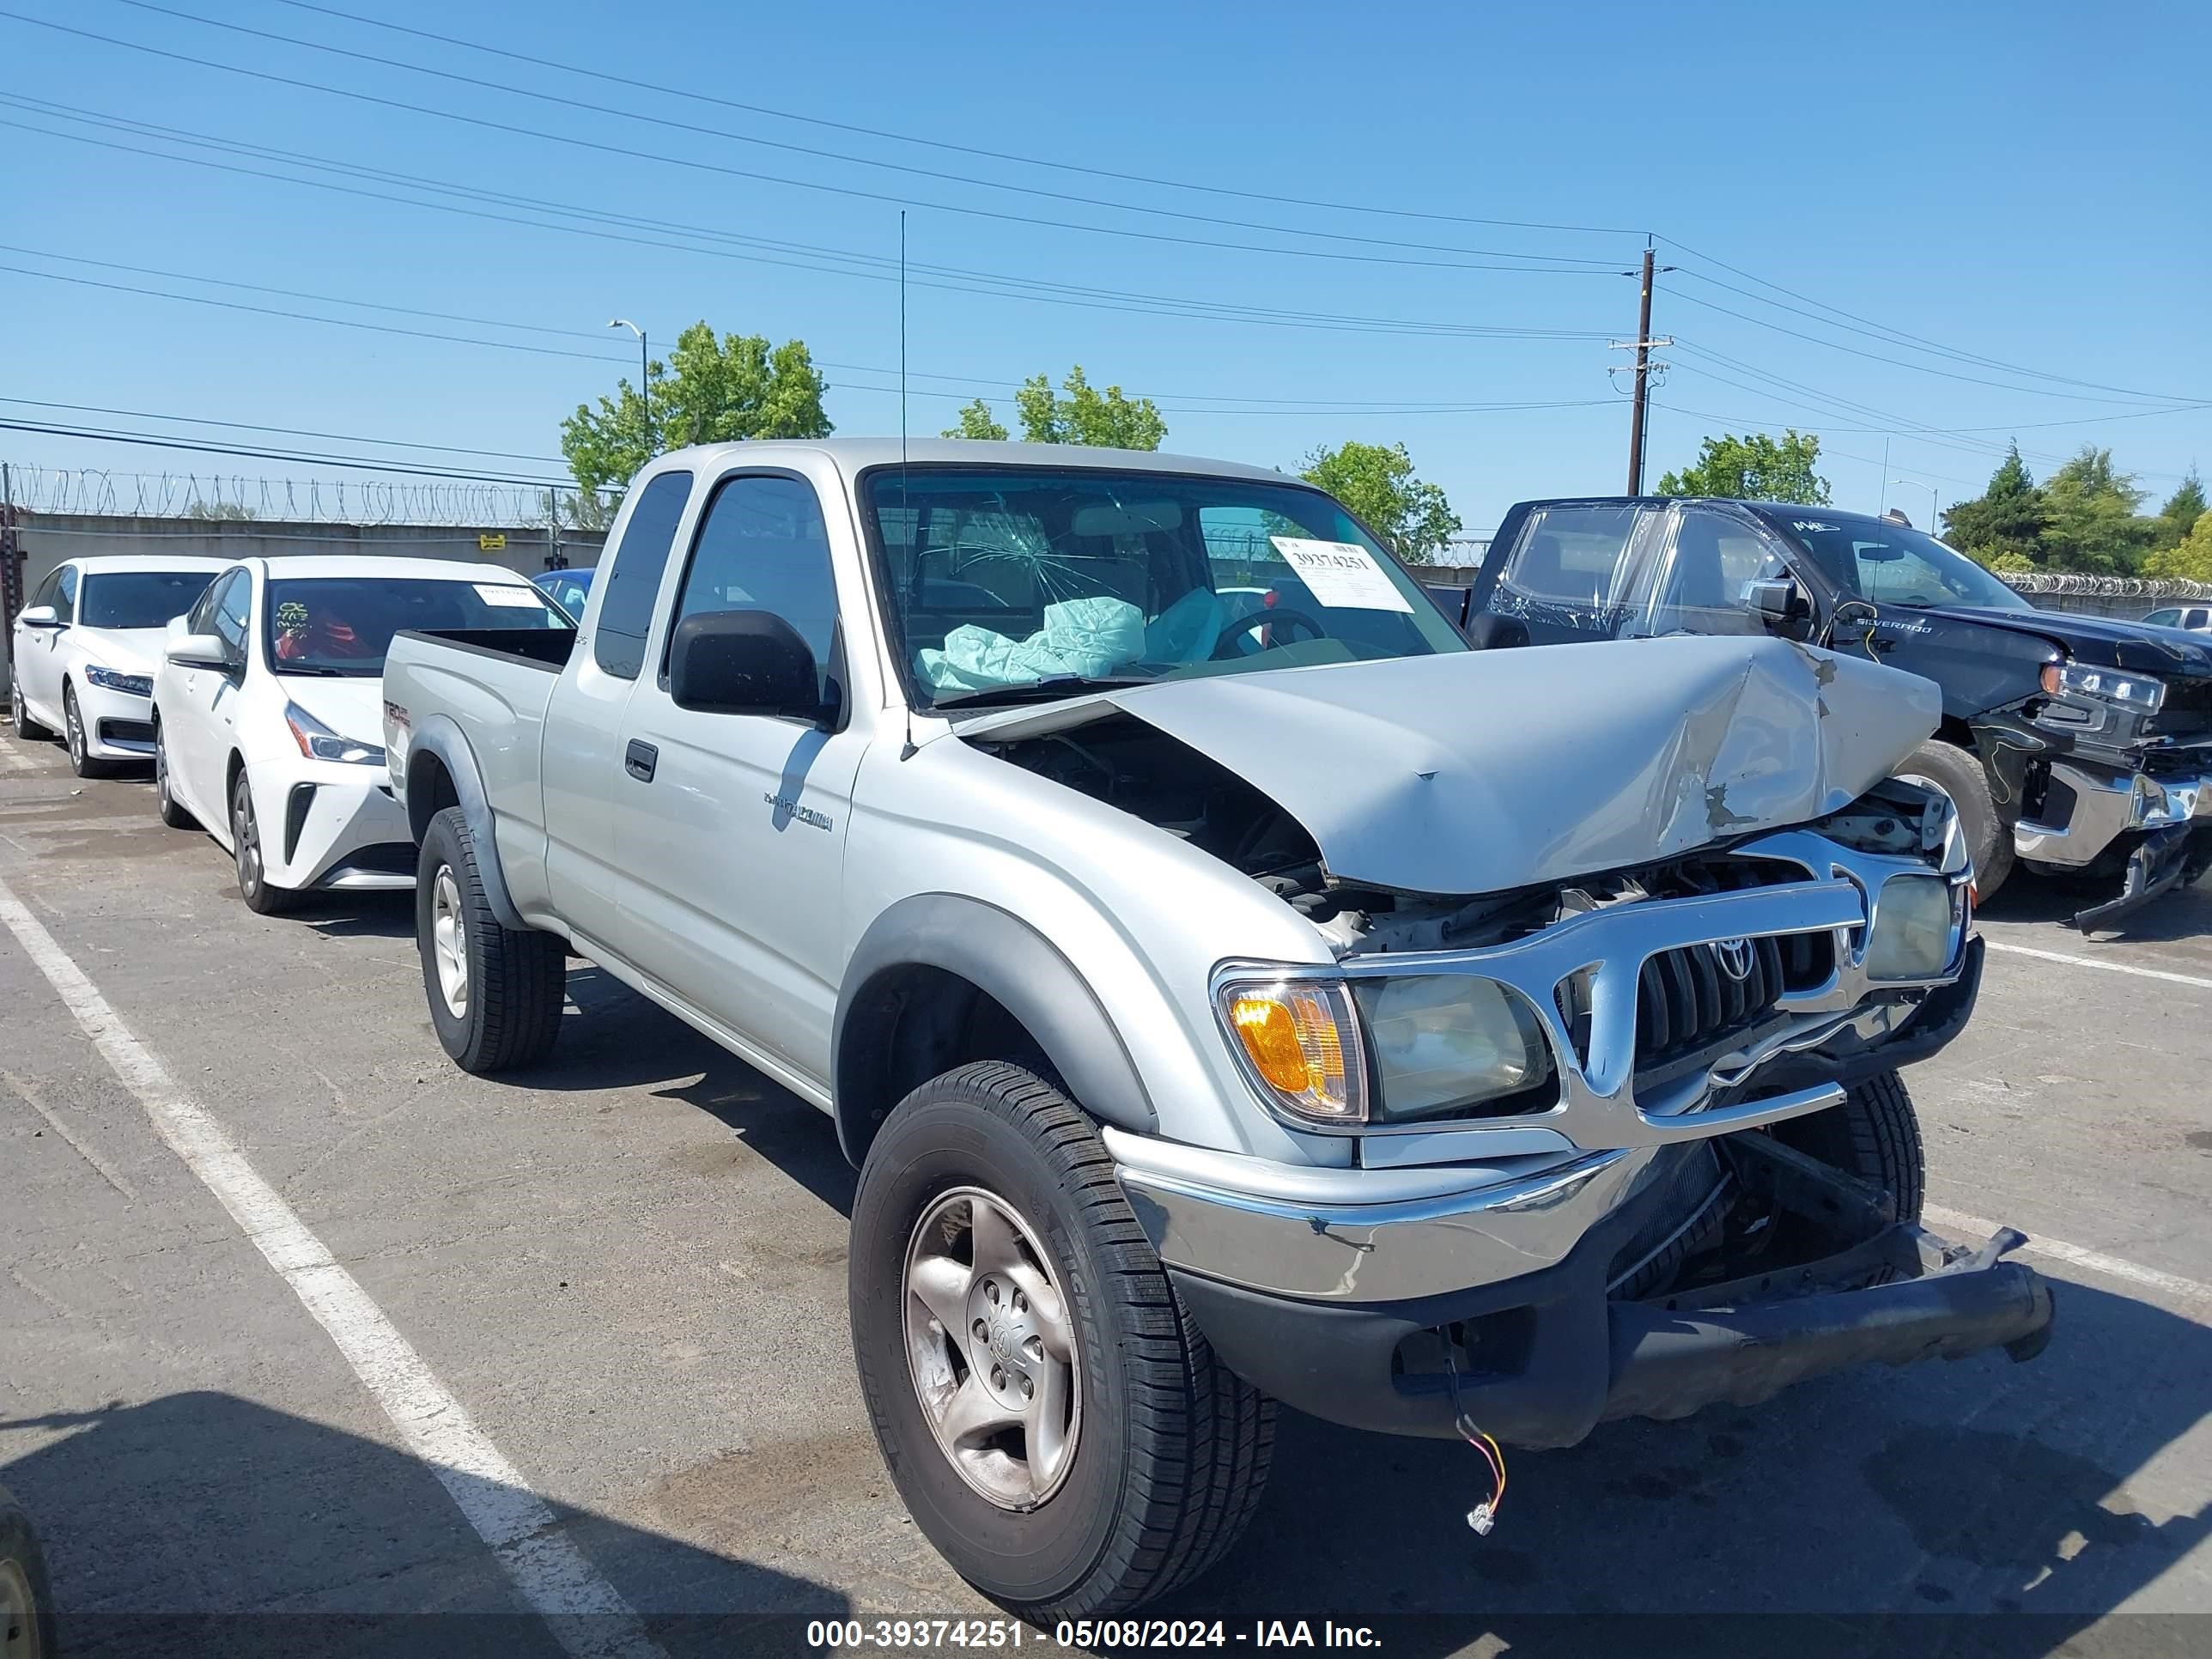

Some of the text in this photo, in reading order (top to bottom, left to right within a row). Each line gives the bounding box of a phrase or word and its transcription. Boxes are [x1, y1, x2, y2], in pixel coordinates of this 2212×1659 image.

[1292, 552, 1370, 570] 39374251
[1856, 617, 1933, 634] SILVERADO
[1048, 1224, 1111, 1413] MICHELIN
